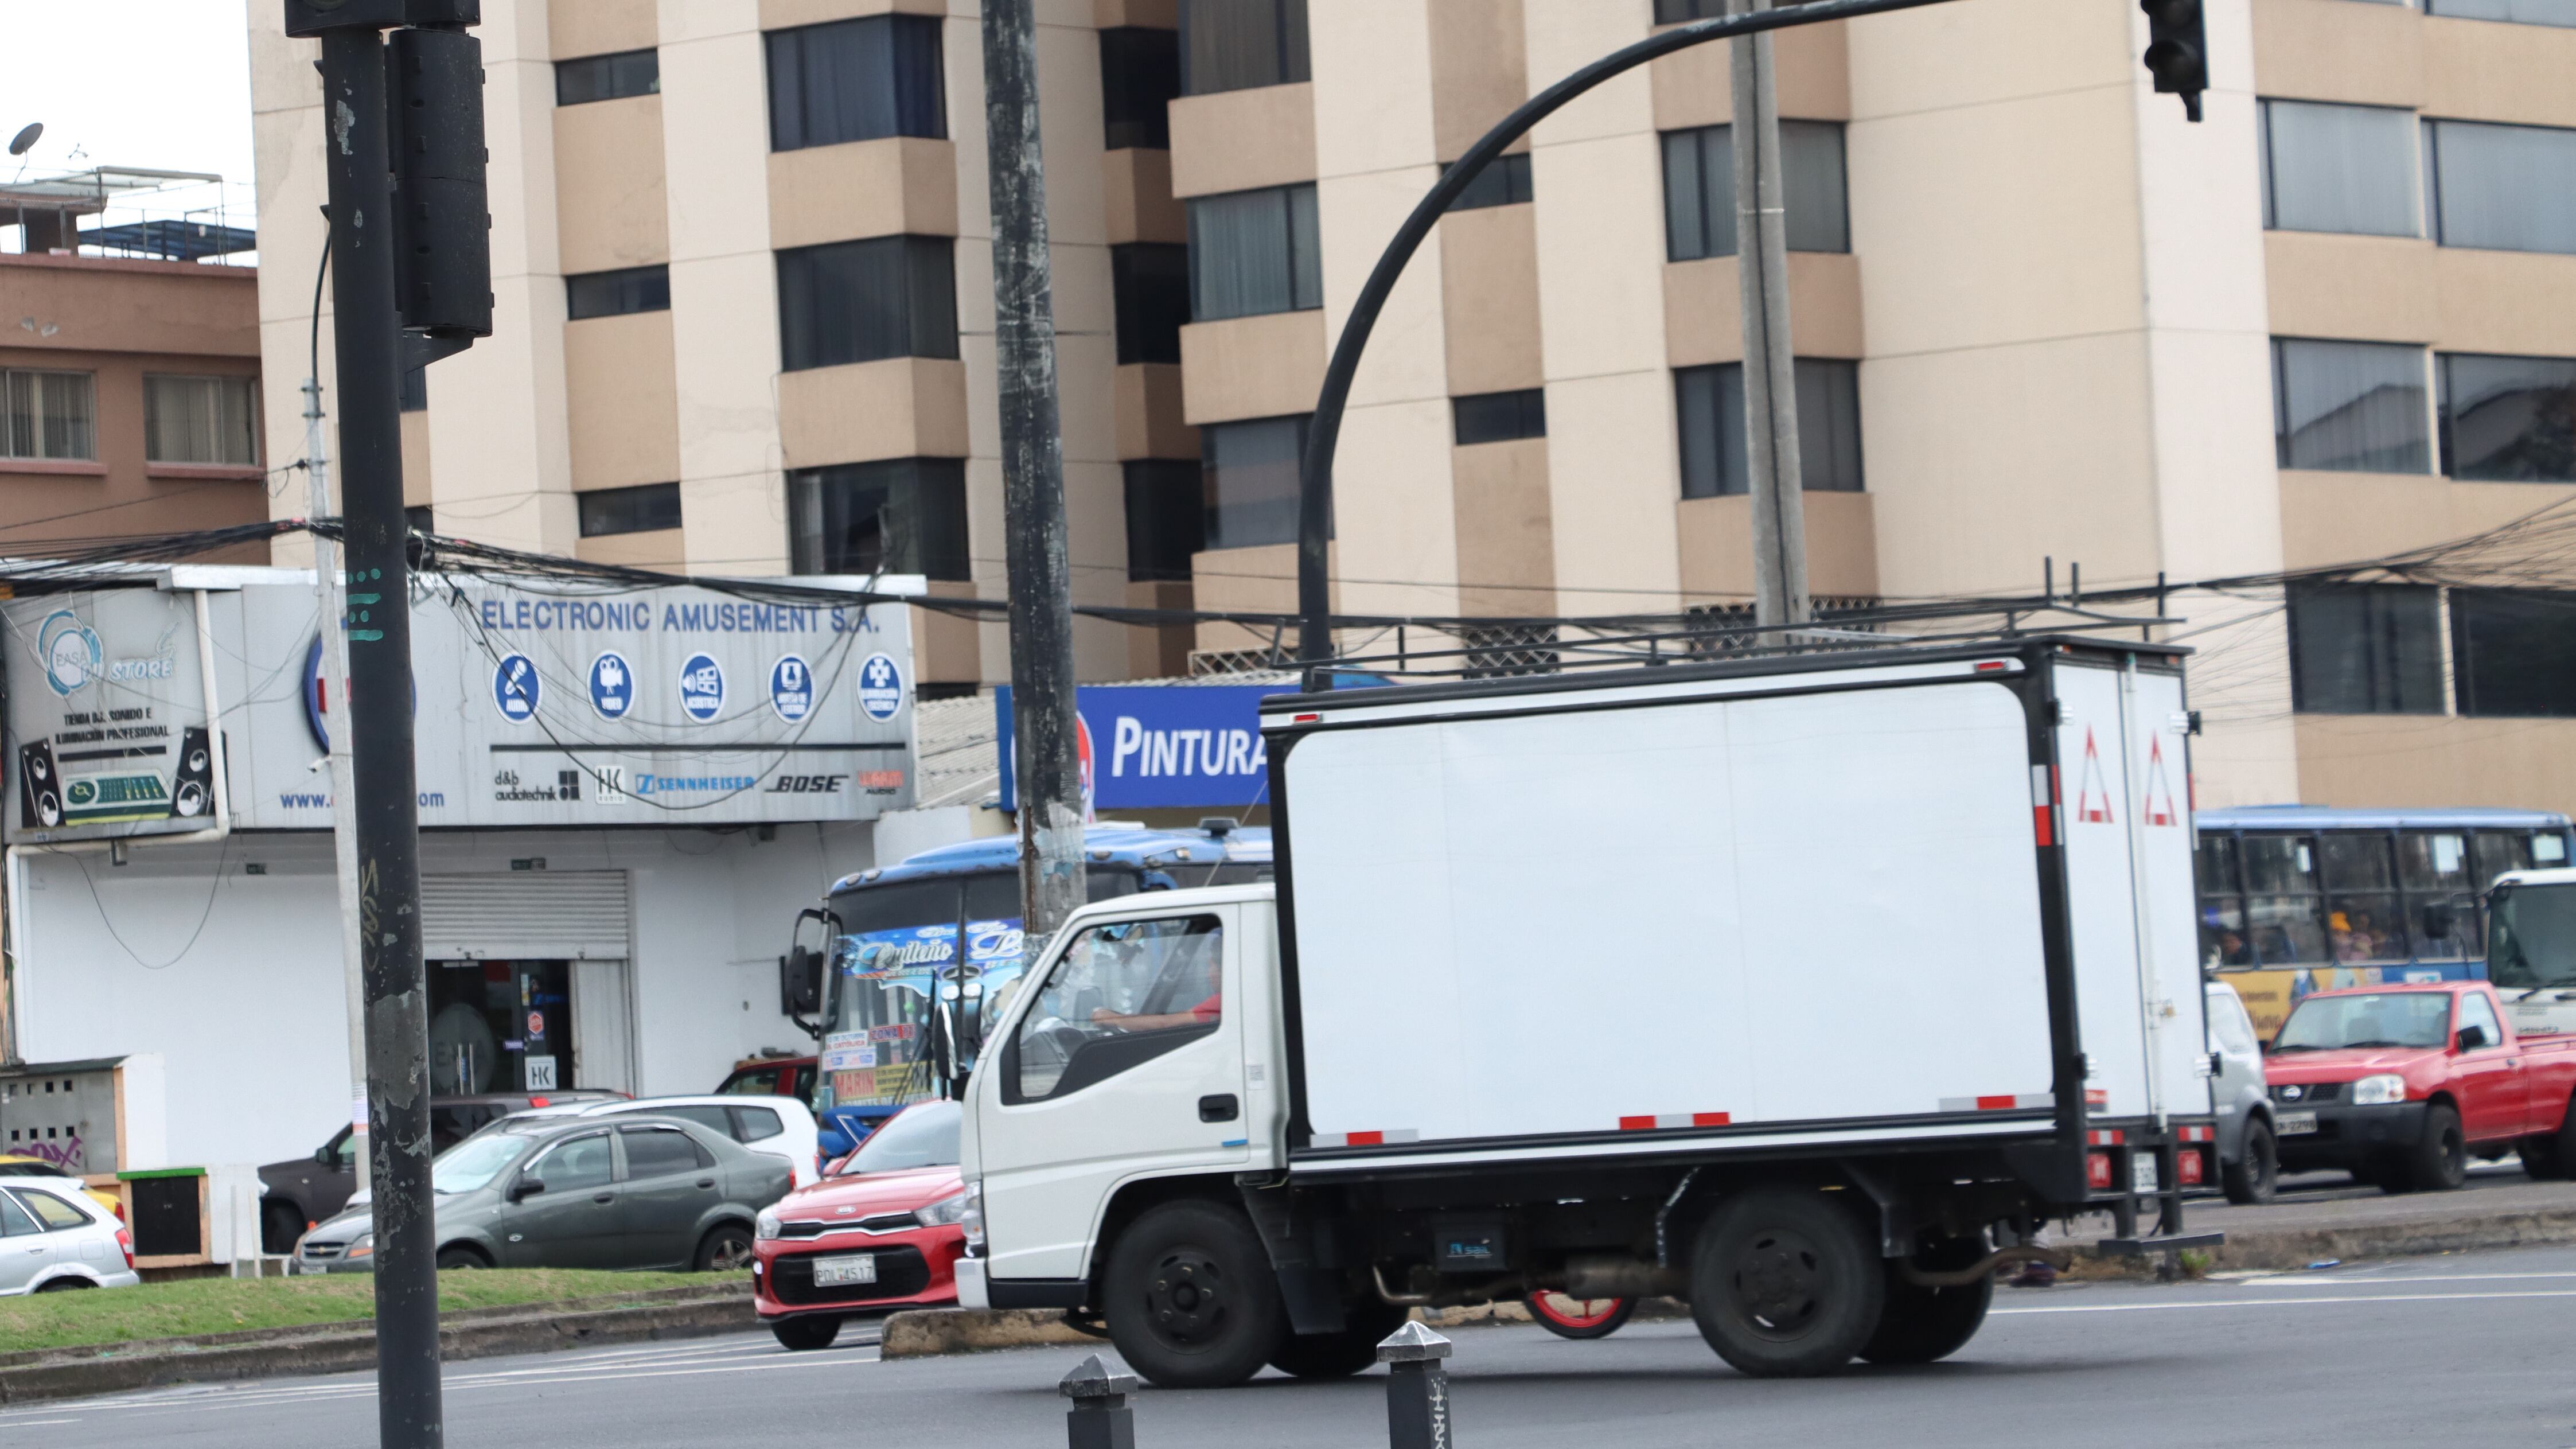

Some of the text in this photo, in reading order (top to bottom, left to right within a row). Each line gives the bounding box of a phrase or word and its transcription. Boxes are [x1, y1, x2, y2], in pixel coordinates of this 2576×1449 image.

[482, 600, 880, 634] ELECTRONIC AMUSEMENT S.A.
[110, 660, 173, 681] STORE
[506, 698, 529, 712] AUDIO
[601, 697, 623, 711] VIDEO
[64, 712, 91, 726] TIENDA
[109, 708, 143, 722] SONIDO
[146, 707, 152, 719] E
[106, 724, 170, 740] PROFESIONAL
[1111, 716, 1267, 777] PINTURA
[494, 770, 519, 785] d&b
[598, 769, 622, 794] HK
[657, 776, 755, 791] SENNHEISER
[765, 776, 849, 793] BOSE
[495, 785, 557, 801] audiotechnik
[531, 1066, 551, 1086] HK
